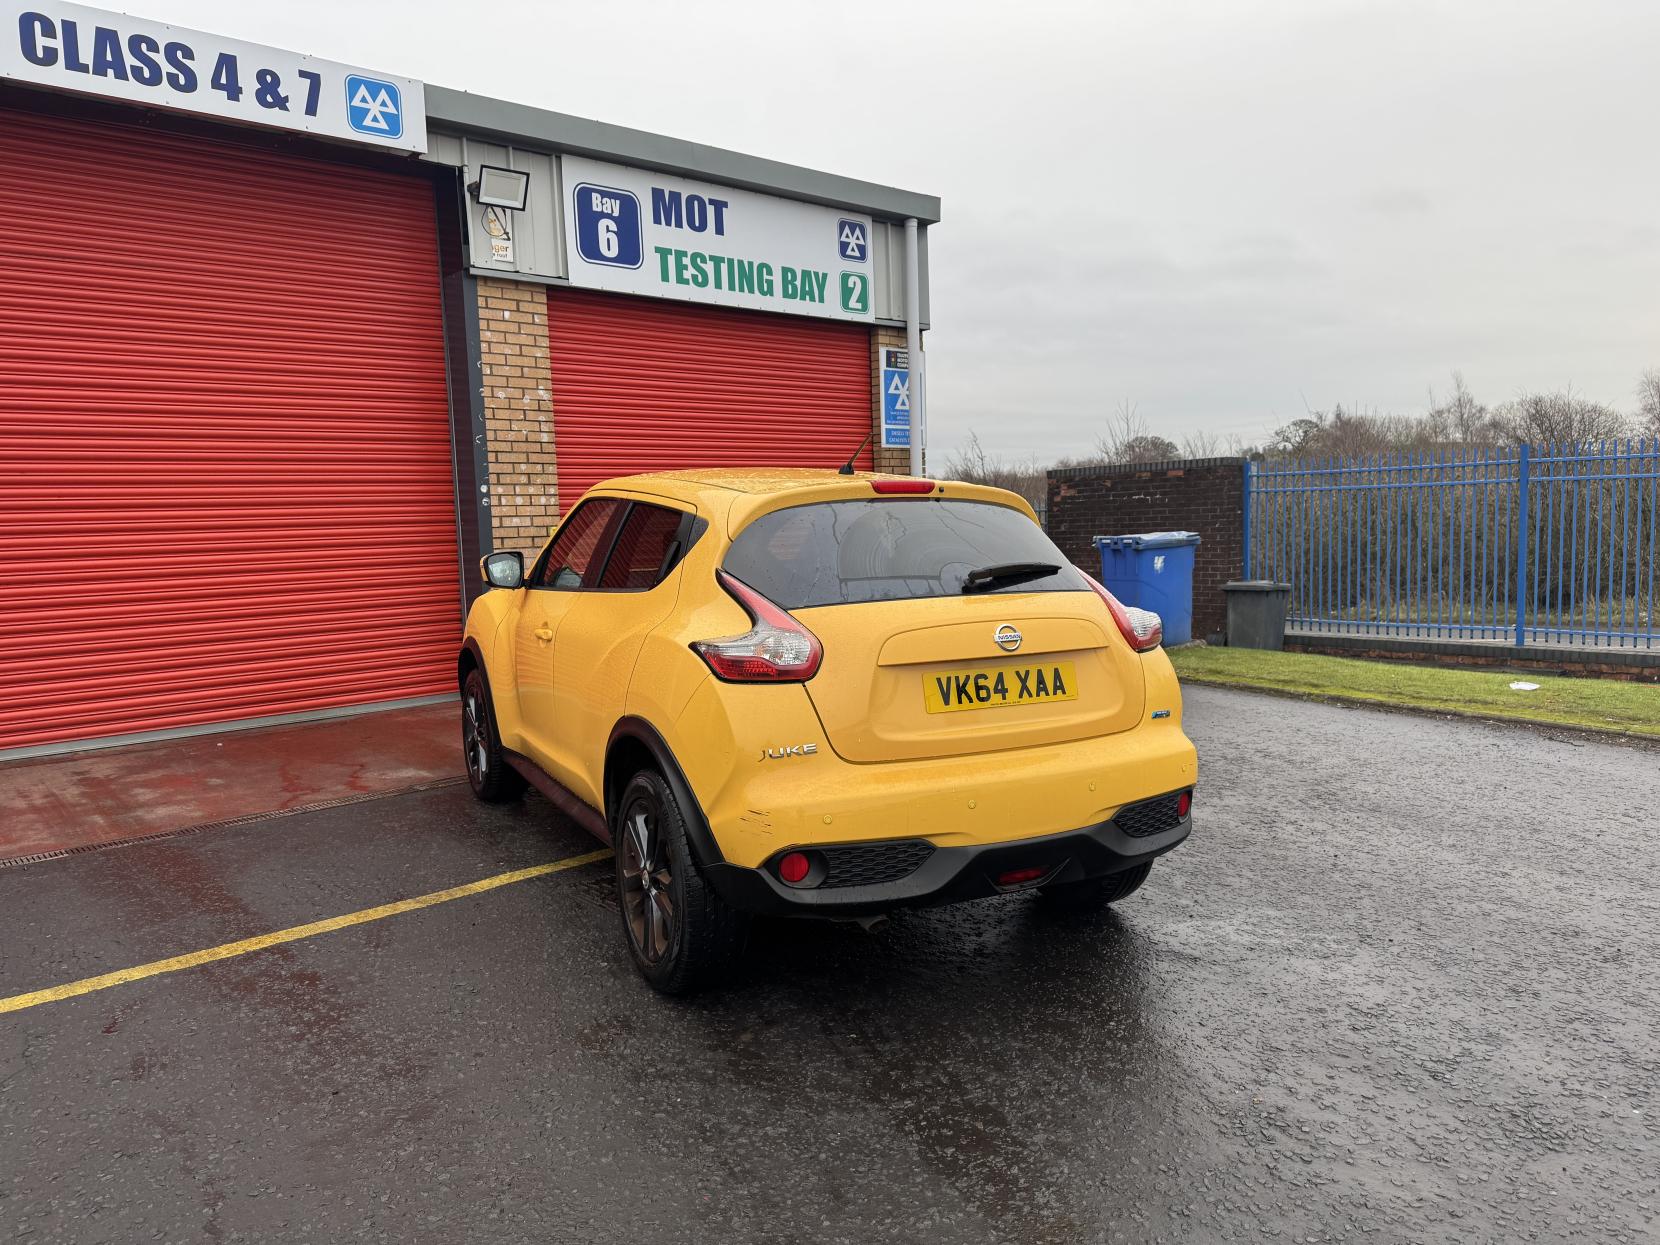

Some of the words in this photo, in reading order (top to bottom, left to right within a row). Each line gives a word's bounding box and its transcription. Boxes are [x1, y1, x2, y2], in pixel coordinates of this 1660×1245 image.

[18, 11, 199, 94] CLASS
[210, 52, 243, 103] 4
[254, 68, 291, 113] &
[298, 69, 322, 118] 7
[591, 192, 620, 217] Bay
[651, 187, 729, 236] MOT
[597, 218, 619, 258] 6
[654, 245, 775, 297] TESTING
[781, 266, 828, 304] BAY
[848, 276, 862, 309] 2
[935, 671, 1009, 707] VK64
[1014, 667, 1067, 699] XAA
[757, 743, 818, 763] JUKE
